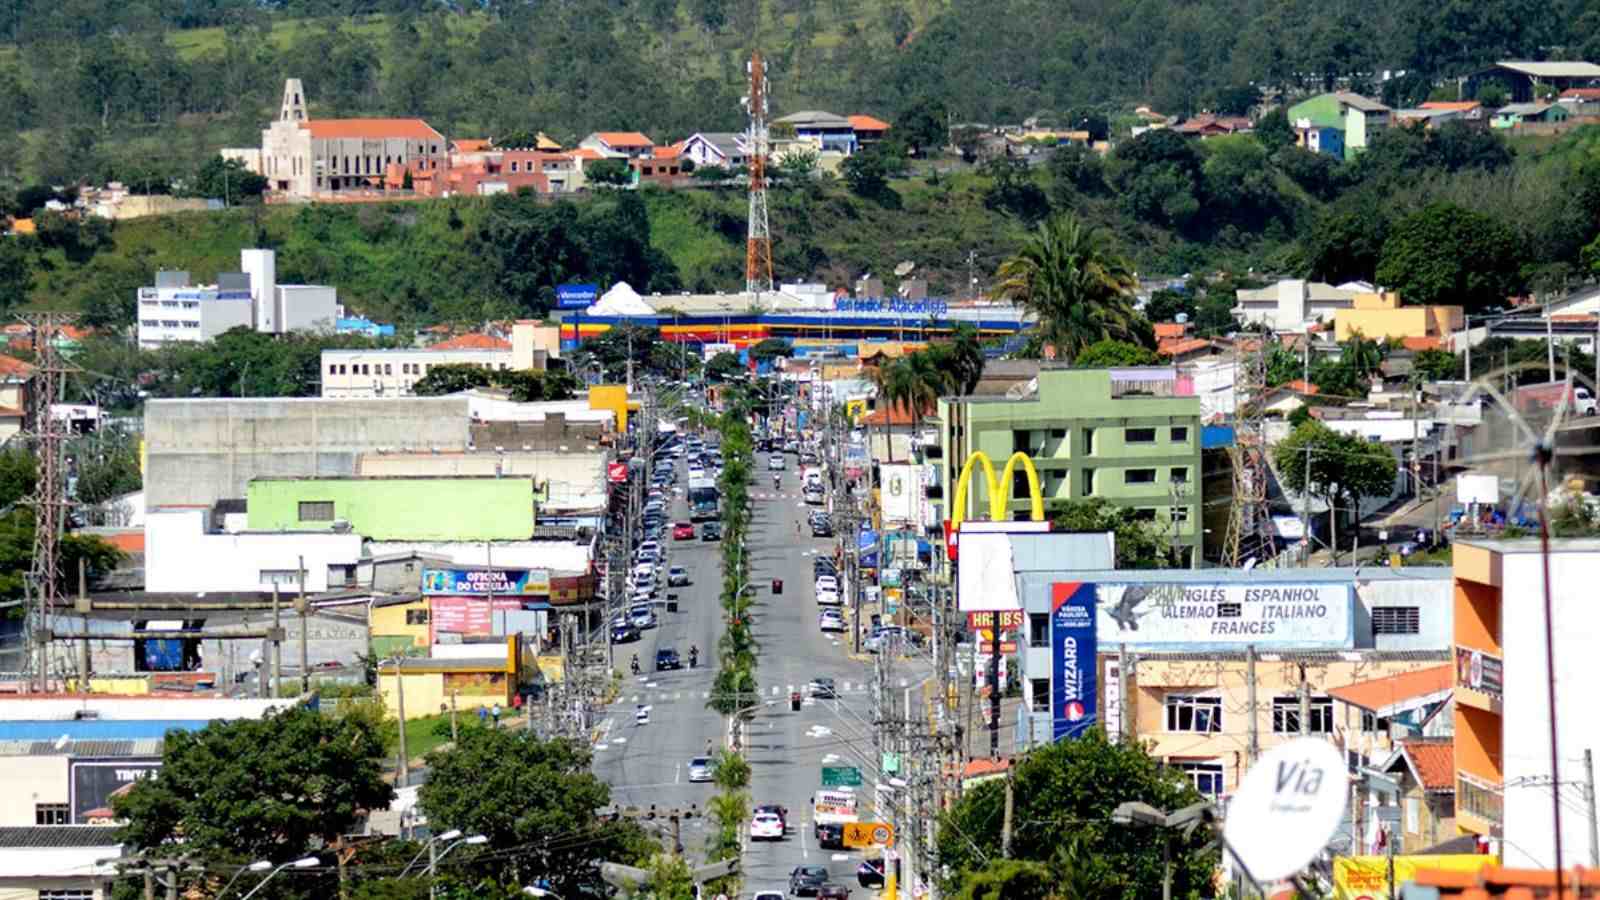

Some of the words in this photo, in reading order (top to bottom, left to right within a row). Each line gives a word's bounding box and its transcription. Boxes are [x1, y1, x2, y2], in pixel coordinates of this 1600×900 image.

[456, 582, 471, 592] DO
[1244, 588, 1321, 602] ESPANHOL
[1262, 605, 1327, 619] ITALIANO
[1063, 636, 1078, 701] WIZARD
[1275, 757, 1324, 796] Via
